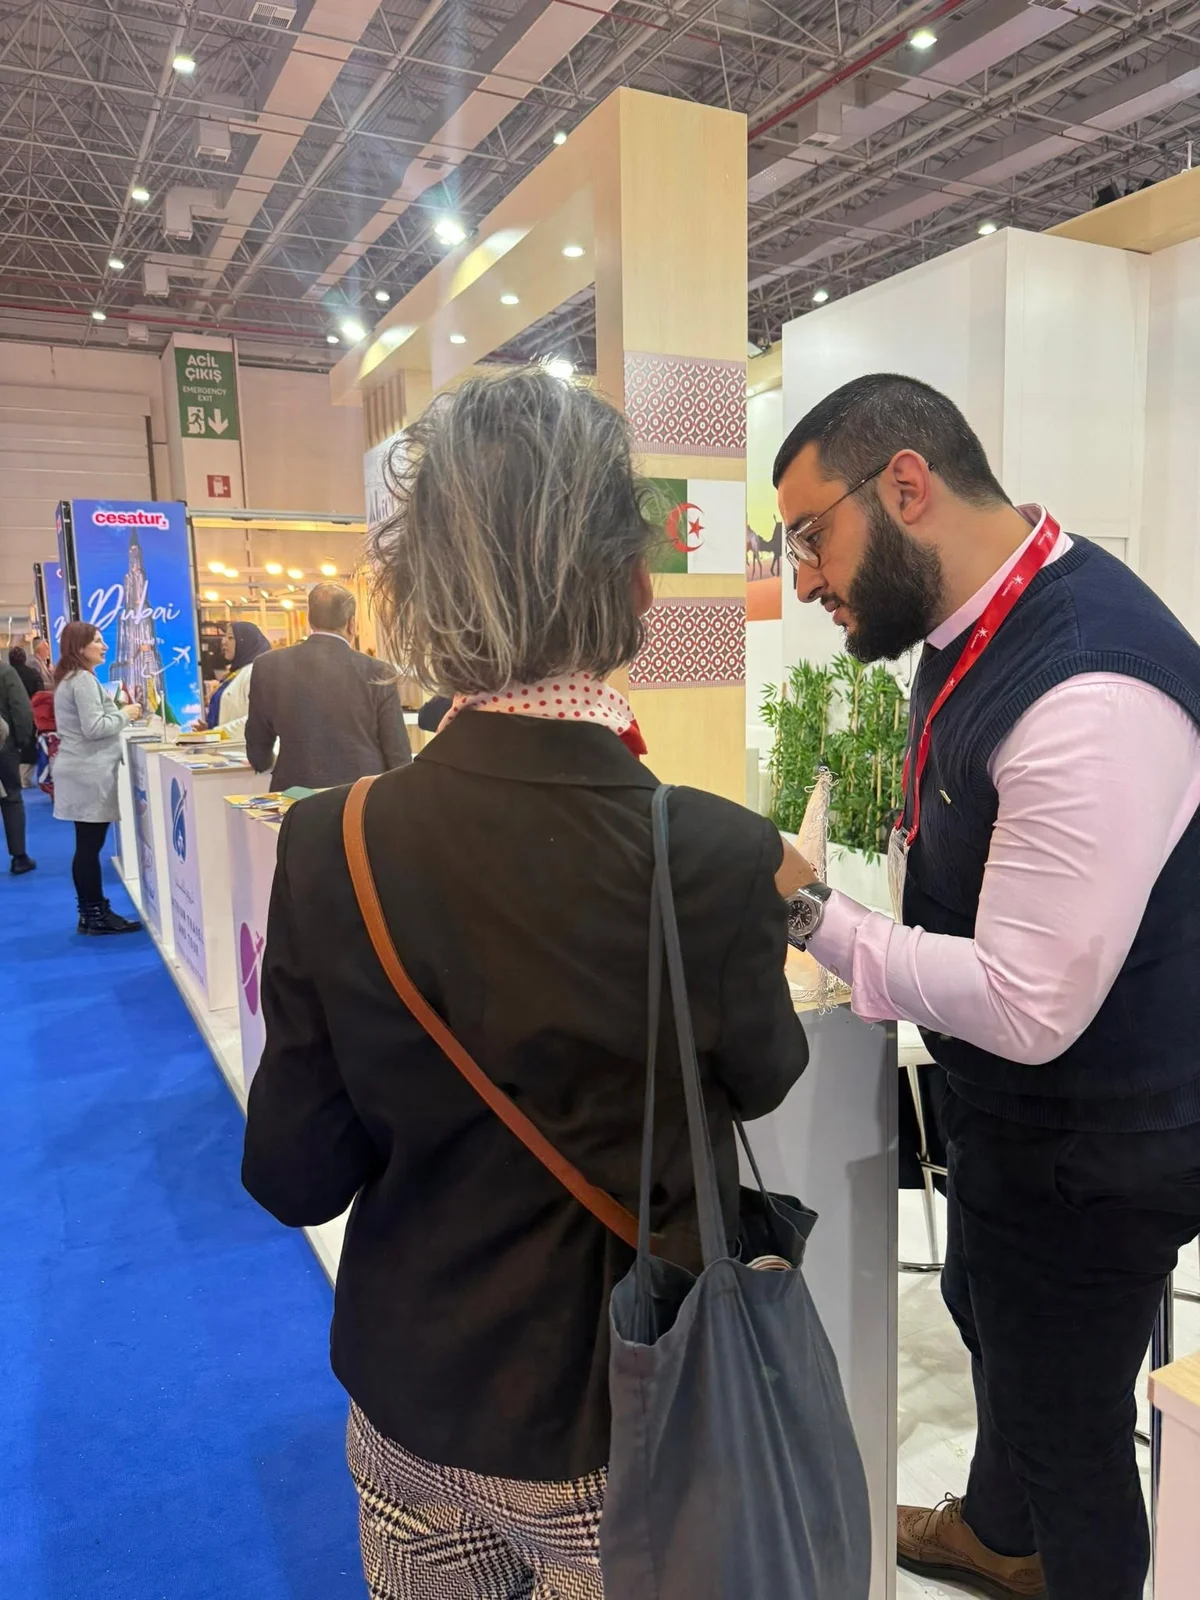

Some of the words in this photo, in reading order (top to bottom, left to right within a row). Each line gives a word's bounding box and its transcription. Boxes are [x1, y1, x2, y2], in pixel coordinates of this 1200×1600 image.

[187, 353, 218, 367] ACİL
[185, 367, 222, 383] ÇIKIŞ
[183, 386, 226, 395] EMERGENCY
[88, 580, 180, 629] Dubai
